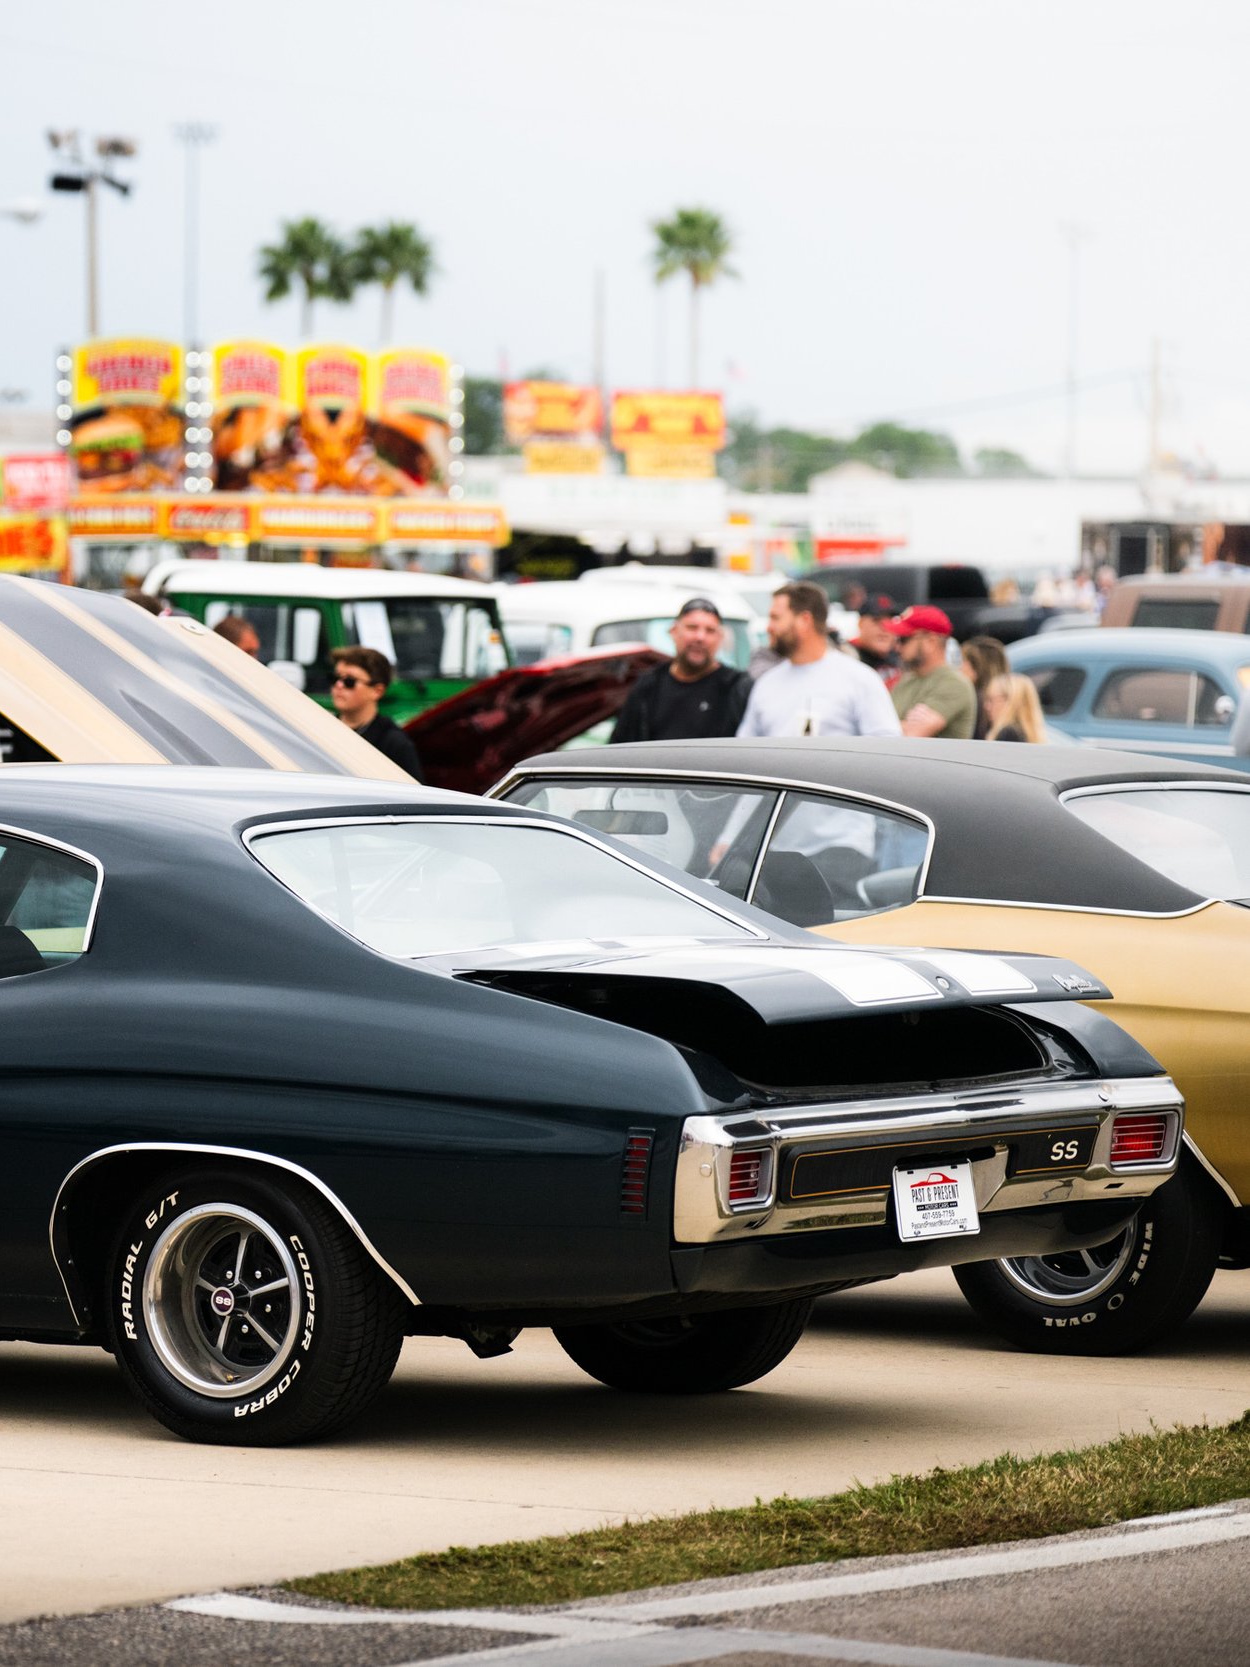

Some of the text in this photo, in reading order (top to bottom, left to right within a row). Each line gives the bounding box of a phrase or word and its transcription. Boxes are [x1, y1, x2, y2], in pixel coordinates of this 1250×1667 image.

[1050, 1140, 1079, 1161] SS
[911, 1187, 926, 1203] PAST
[933, 1184, 960, 1201] PRESENT
[121, 1190, 180, 1341] RADIAL G/T
[1041, 1222, 1153, 1328] WIDE OVAL
[215, 1295, 232, 1306] SS
[233, 1234, 316, 1418] COOPER COBRA
